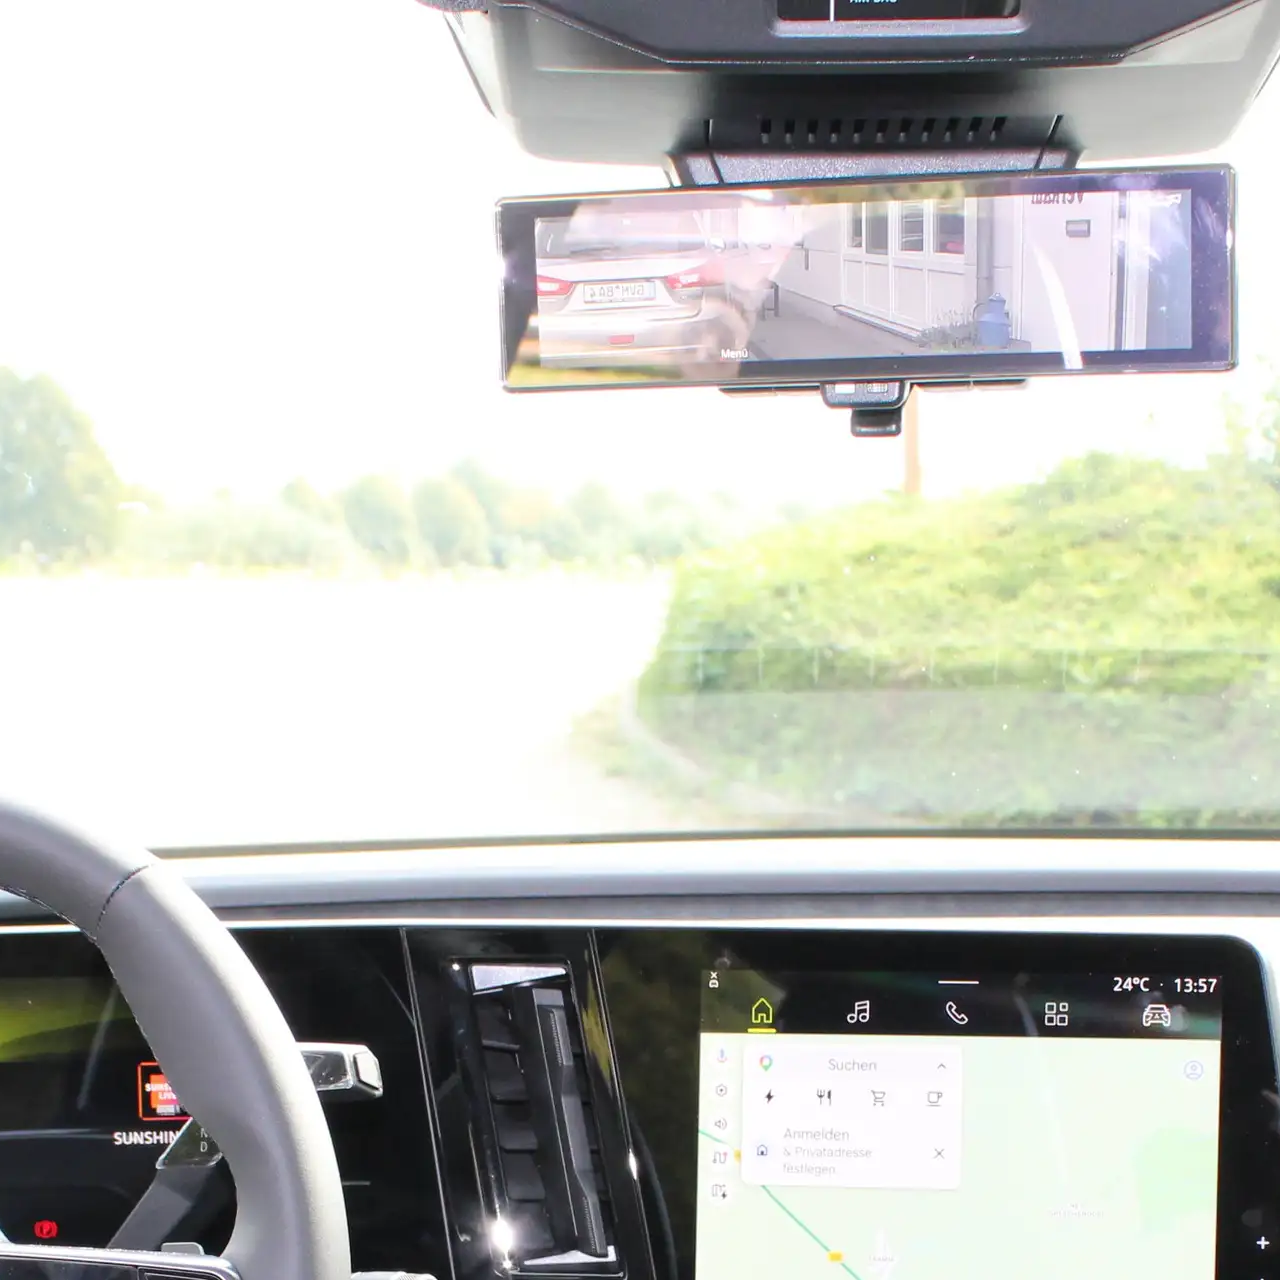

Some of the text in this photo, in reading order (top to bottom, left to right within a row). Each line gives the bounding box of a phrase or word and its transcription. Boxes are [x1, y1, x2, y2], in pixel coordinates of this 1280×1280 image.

[1113, 977, 1218, 993] 24°C 13:57
[827, 1058, 877, 1072] Suchen
[783, 1127, 850, 1141] Anmelden
[795, 1147, 872, 1159] Privatadresse
[783, 1162, 836, 1176] festlegen
